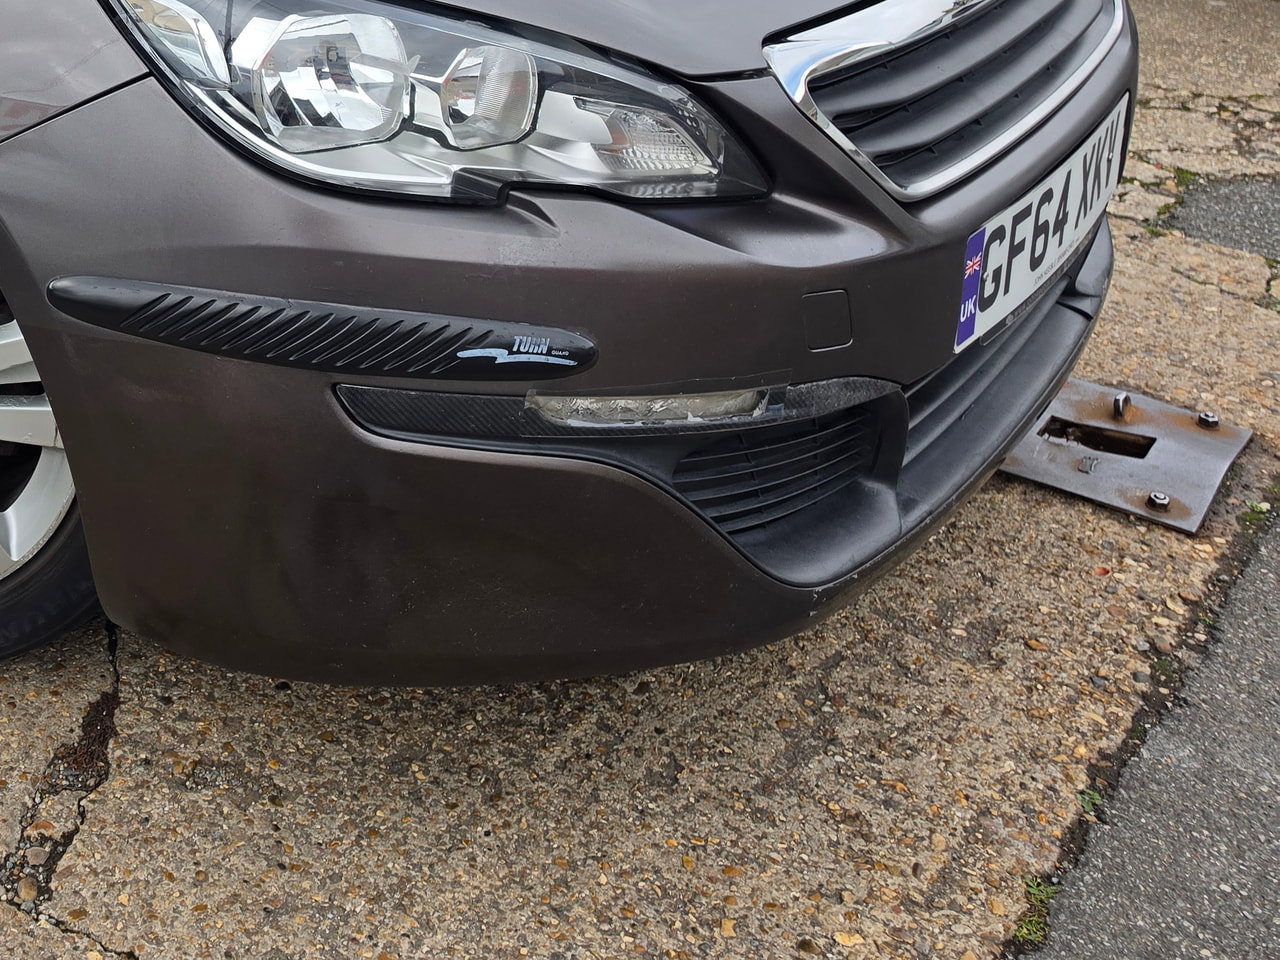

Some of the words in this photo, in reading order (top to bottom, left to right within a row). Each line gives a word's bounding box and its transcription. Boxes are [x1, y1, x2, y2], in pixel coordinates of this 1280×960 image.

[977, 169, 1072, 313] GF64
[960, 296, 976, 323] UK
[512, 335, 550, 355] TURN
